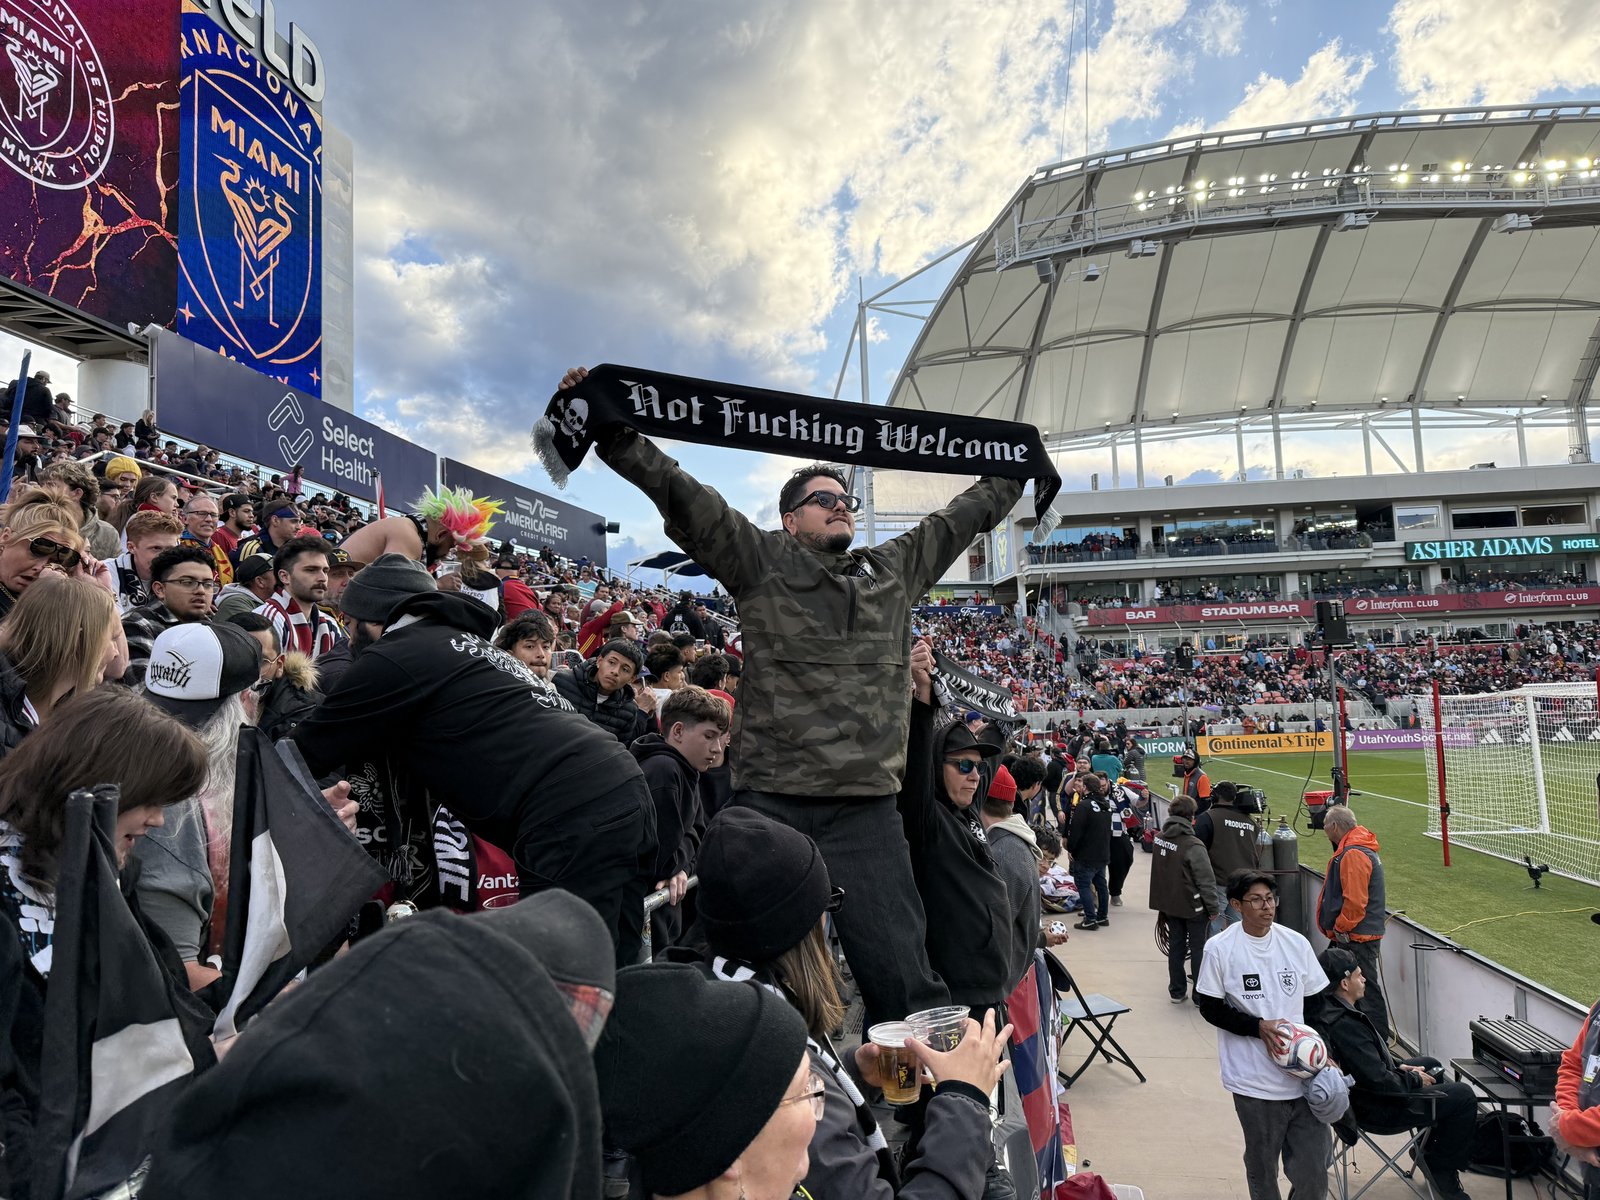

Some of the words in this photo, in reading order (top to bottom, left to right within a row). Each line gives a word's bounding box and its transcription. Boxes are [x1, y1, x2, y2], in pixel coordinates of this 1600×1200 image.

[0, 7, 65, 65] MIAMI
[84, 60, 102, 87] DE
[2, 136, 56, 178] MMXX
[211, 104, 300, 195] MIAMI
[619, 379, 705, 425] Not
[713, 395, 864, 455] Fucking
[874, 418, 1029, 463] Welcome
[322, 416, 375, 459] Select
[321, 445, 372, 487] Health
[504, 510, 545, 533] AMERICA
[545, 522, 568, 541] FIRST
[520, 530, 539, 541] CREDIT
[540, 537, 556, 545] UNION
[1411, 541, 1479, 560] ASHER
[1481, 537, 1553, 557] ADAMS
[1562, 538, 1600, 549] HOTEL
[1201, 605, 1267, 617] STADIUM
[1268, 604, 1300, 614] BAR
[1370, 598, 1415, 611] Interform
[1416, 599, 1439, 608] CLUB
[1519, 591, 1564, 604] Interform
[1565, 592, 1589, 601] CLUB
[1125, 610, 1157, 620] BAR
[150, 661, 192, 688] wraith
[1209, 735, 1283, 753] Continental
[1293, 734, 1325, 747] Tire
[1358, 731, 1472, 745] UtahYouthSocer.net
